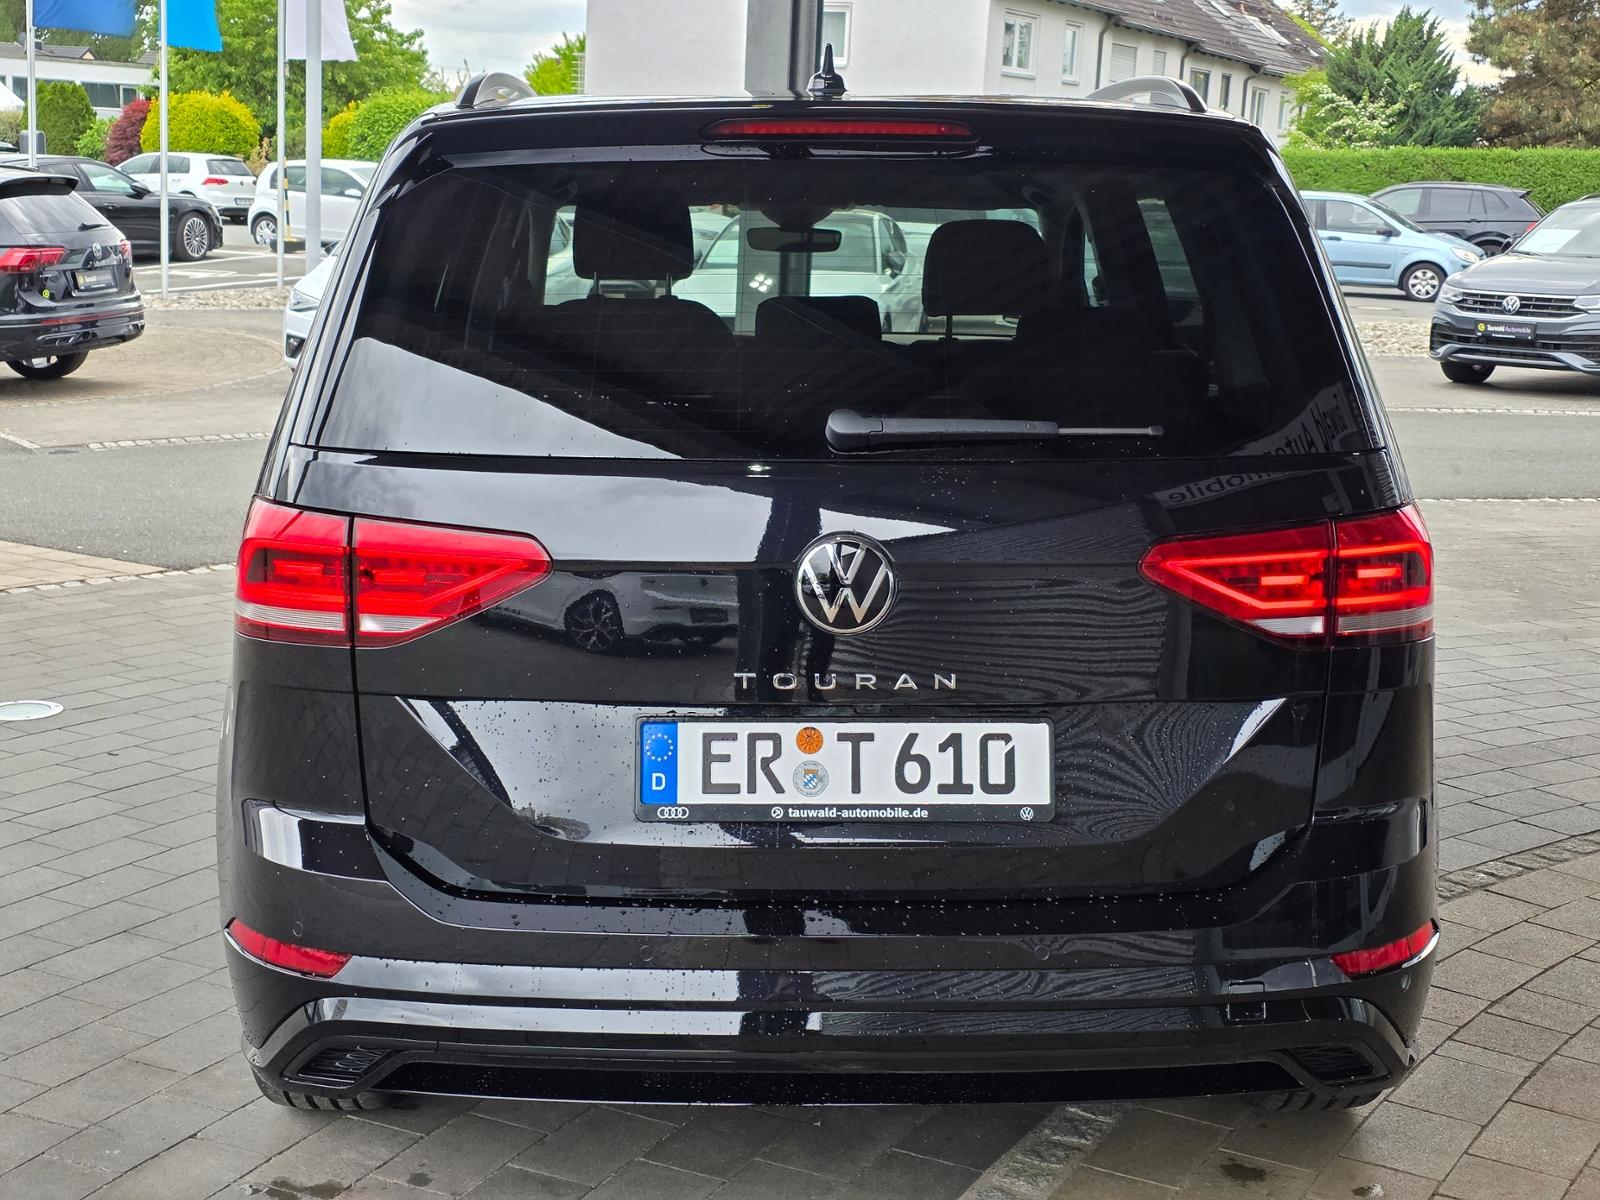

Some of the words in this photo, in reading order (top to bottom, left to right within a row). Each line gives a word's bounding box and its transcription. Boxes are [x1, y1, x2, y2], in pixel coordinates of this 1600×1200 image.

[733, 672, 959, 691] TOURAN
[702, 732, 785, 795] ER
[836, 732, 875, 795] T
[894, 732, 1016, 795] 610
[652, 773, 666, 791] D
[788, 807, 929, 819] tauwald-automobile.de
